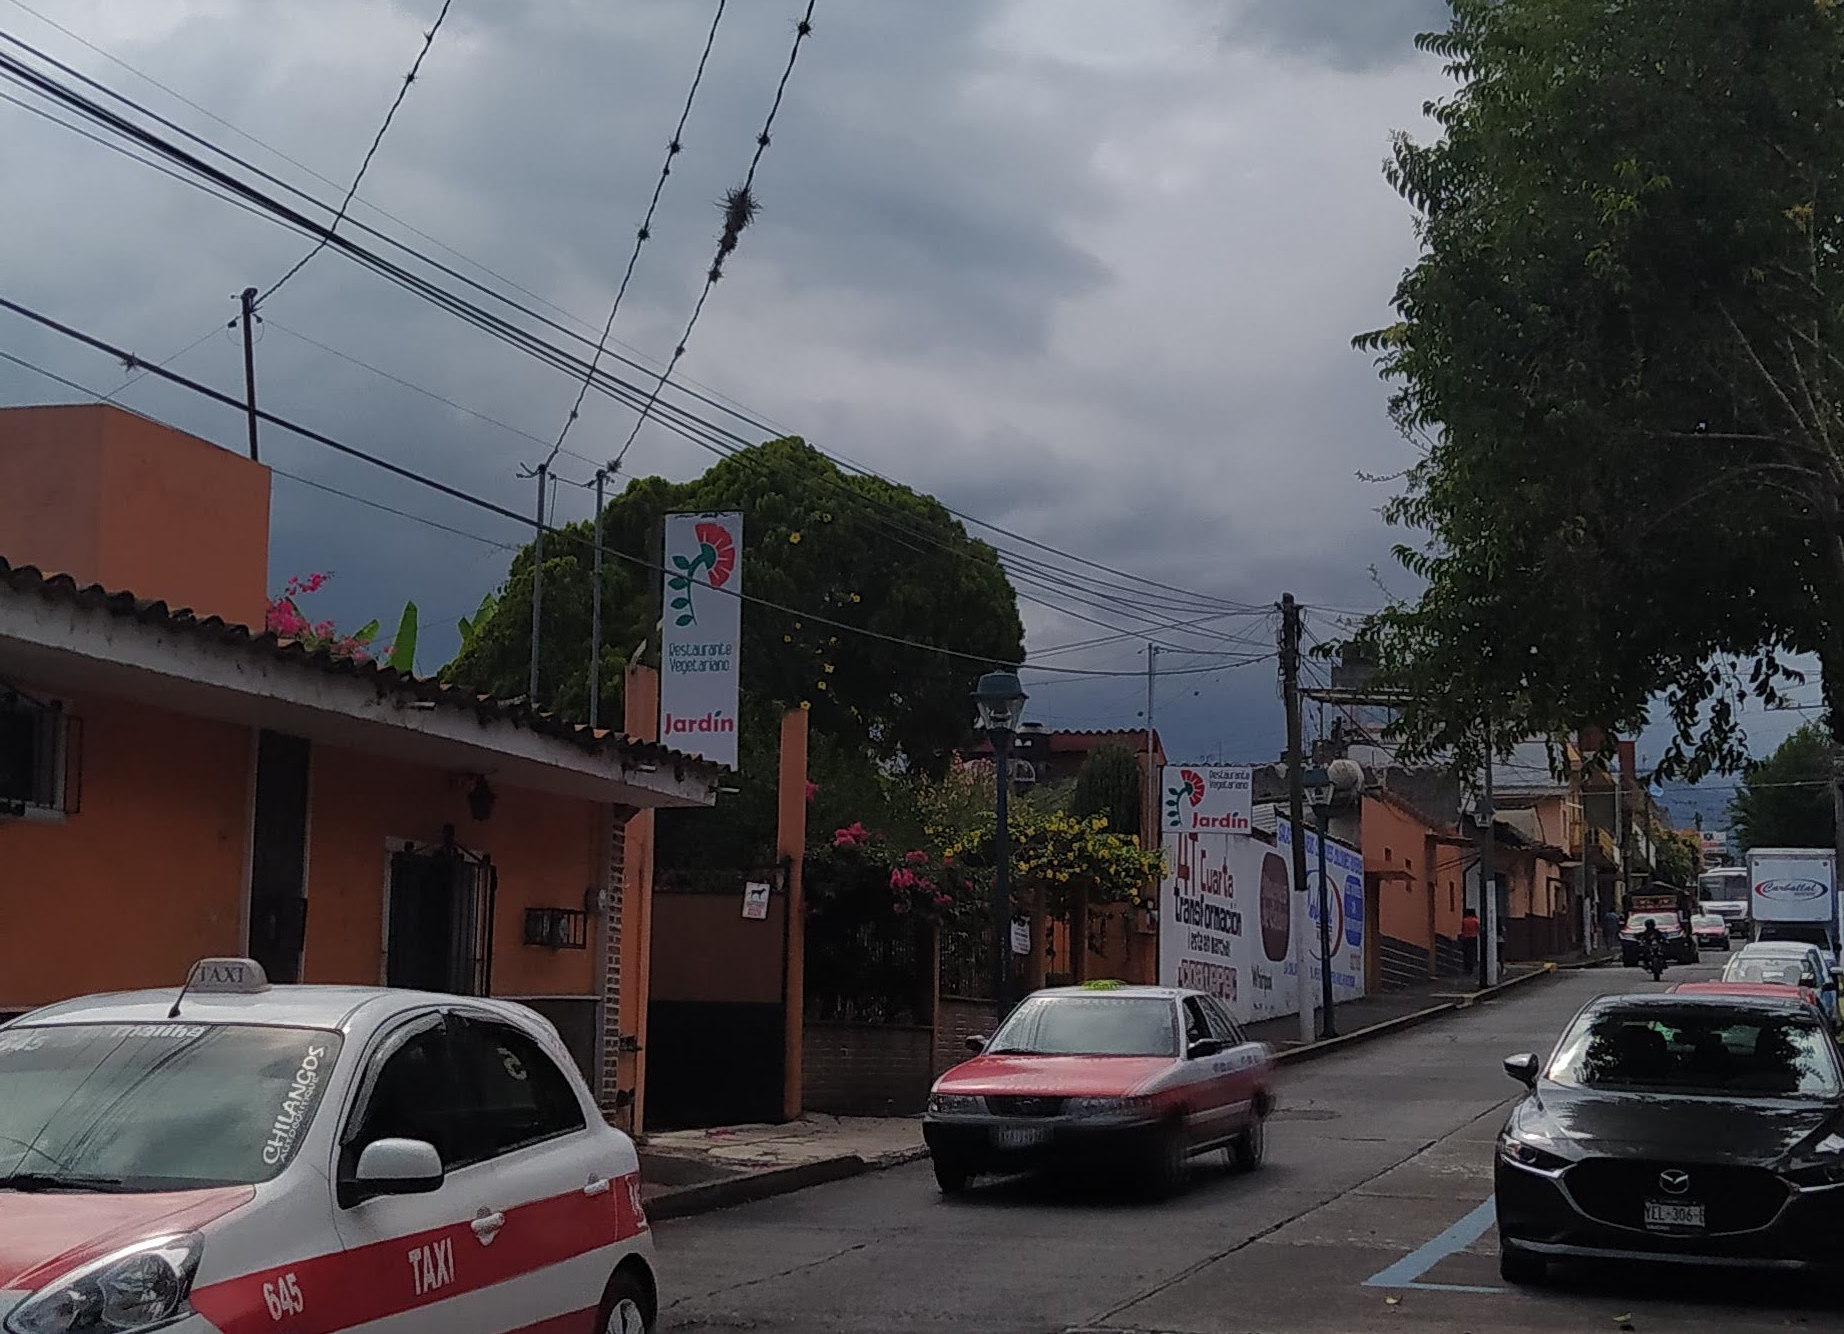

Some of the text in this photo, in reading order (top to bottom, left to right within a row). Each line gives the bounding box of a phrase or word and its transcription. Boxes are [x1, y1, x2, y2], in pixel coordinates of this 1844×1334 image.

[669, 643, 732, 656] Restaurante
[669, 658, 730, 674] Vegetariano
[664, 710, 734, 735] Jardín
[1192, 811, 1248, 828] Jardín
[1200, 850, 1233, 898] Cuarta
[200, 966, 245, 983] TAXI
[263, 1045, 325, 1164] CHILANGOS
[408, 1237, 455, 1296] TAXI
[263, 1272, 304, 1321] 645
